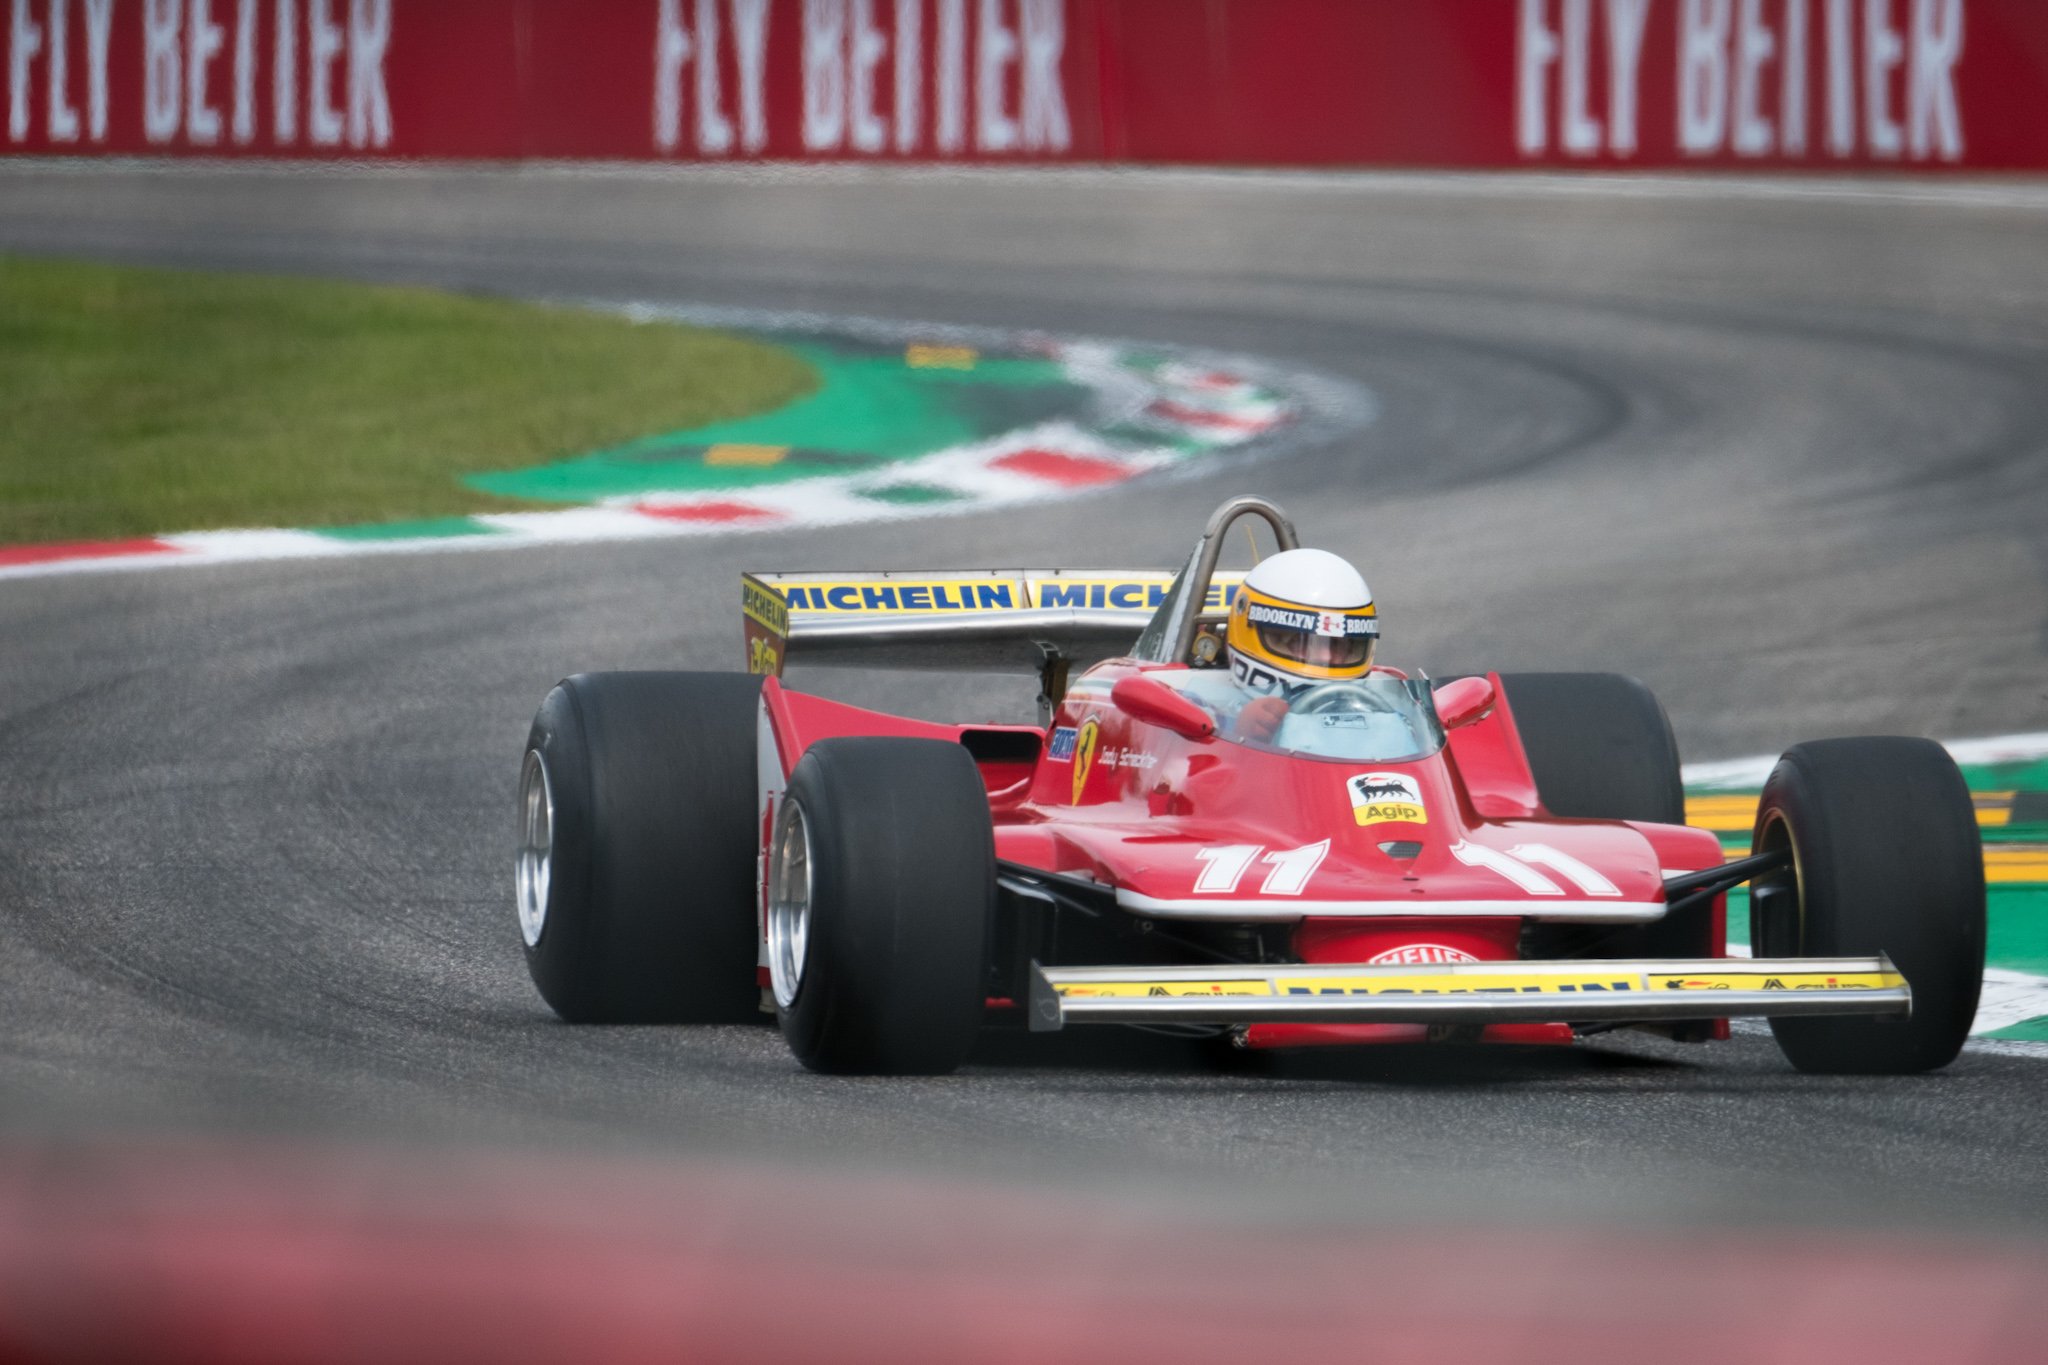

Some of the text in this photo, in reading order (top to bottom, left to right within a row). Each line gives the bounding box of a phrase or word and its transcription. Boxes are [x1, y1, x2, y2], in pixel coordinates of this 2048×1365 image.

[743, 583, 787, 634] MICHELIN
[1248, 605, 1316, 630] BROOKLYN
[1365, 804, 1418, 820] Agip
[1193, 839, 1331, 895] 11
[1449, 839, 1623, 897] 11
